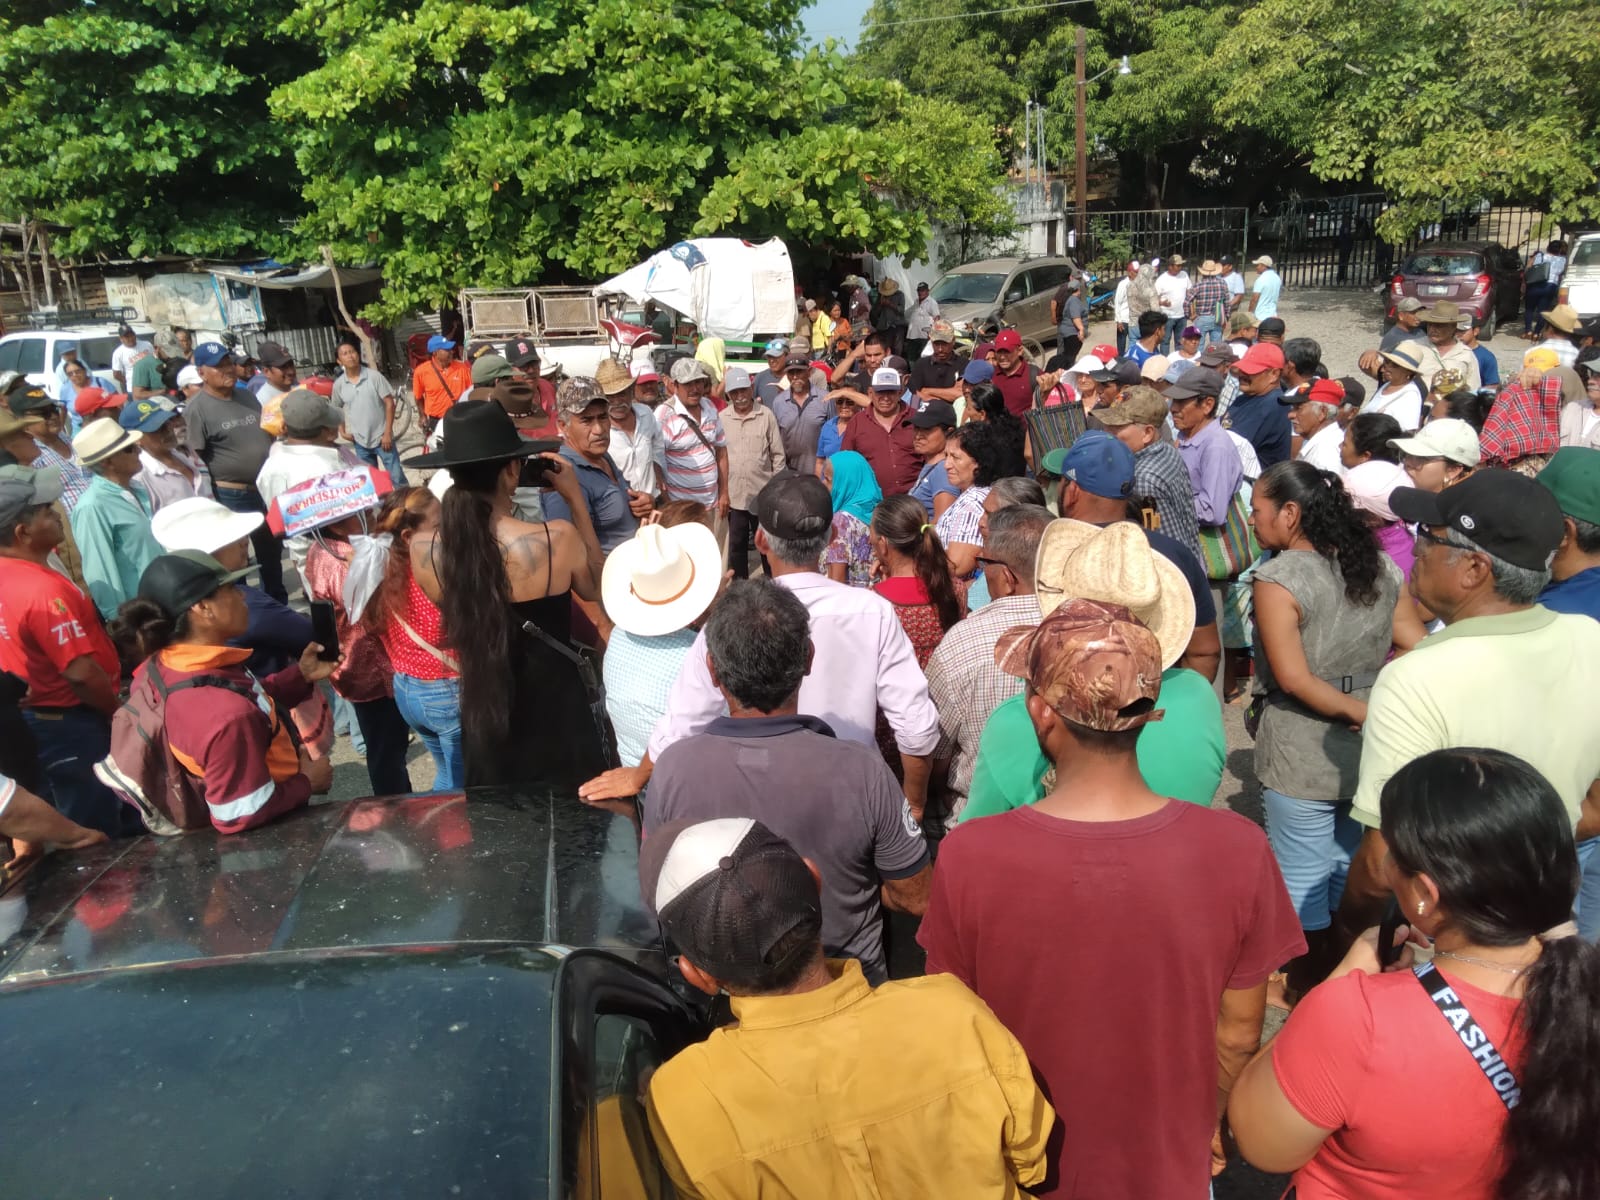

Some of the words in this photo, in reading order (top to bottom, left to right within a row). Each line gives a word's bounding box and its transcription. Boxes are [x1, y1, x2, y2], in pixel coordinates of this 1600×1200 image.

[118, 285, 139, 296] VOTA
[51, 619, 86, 645] ZTE
[1431, 986, 1522, 1109] FASHION
